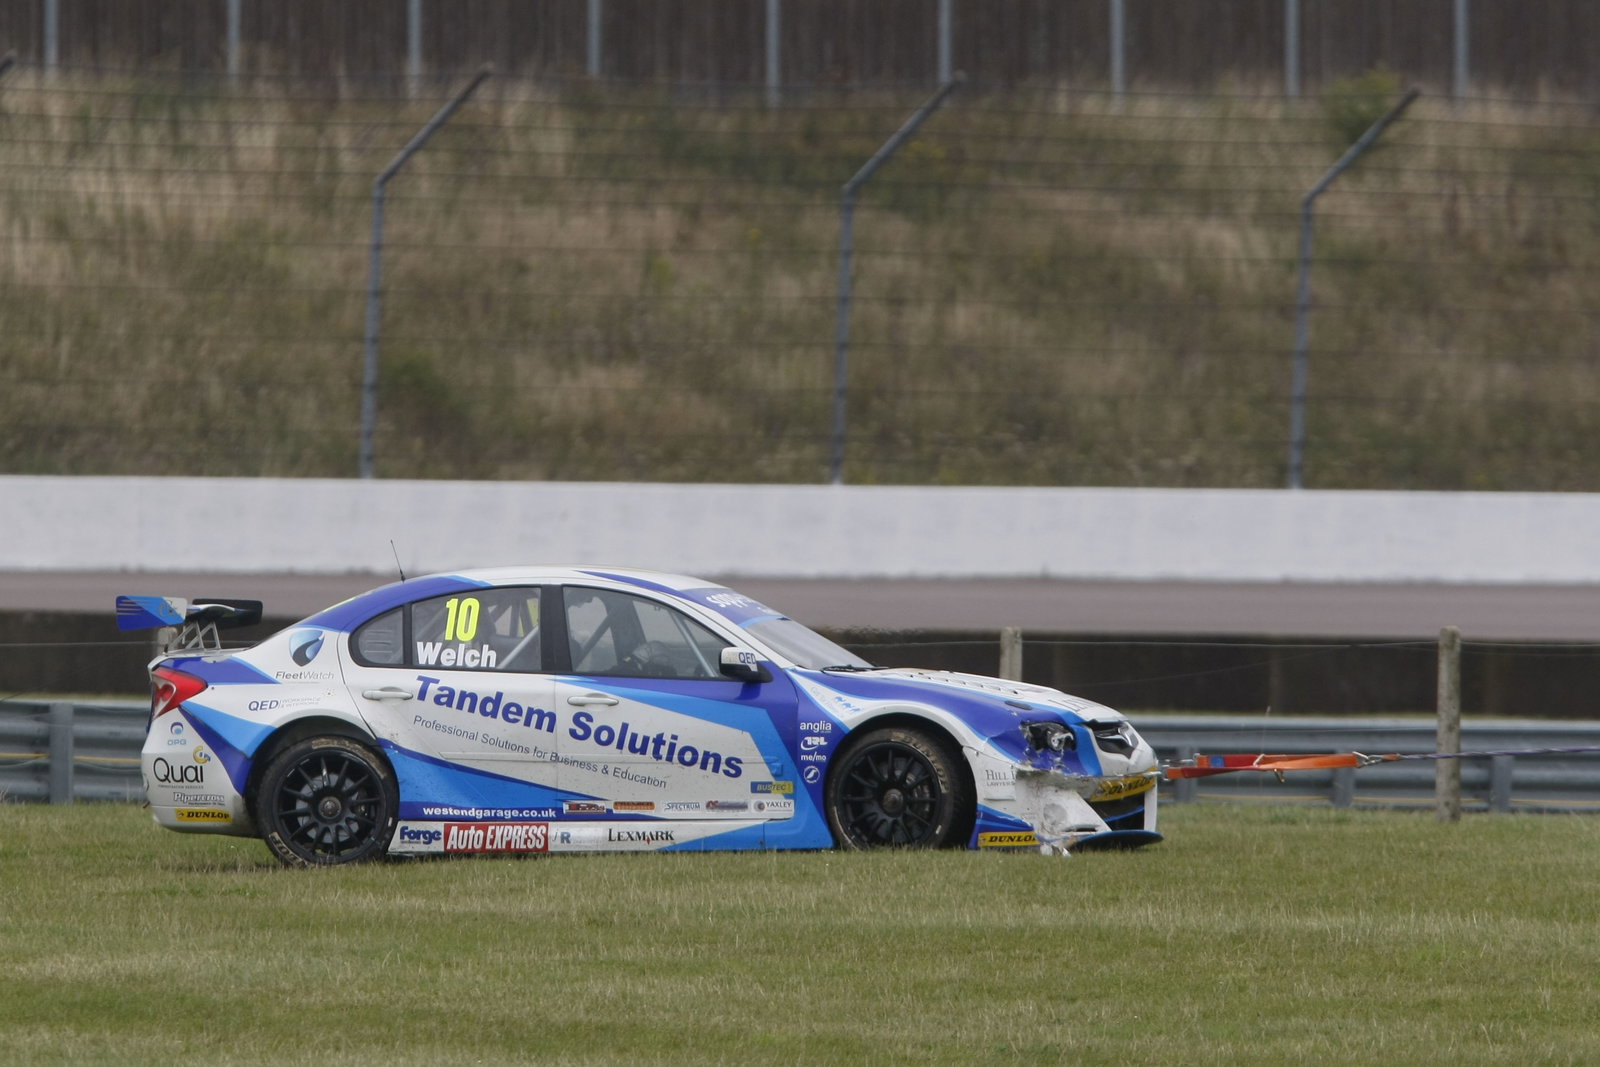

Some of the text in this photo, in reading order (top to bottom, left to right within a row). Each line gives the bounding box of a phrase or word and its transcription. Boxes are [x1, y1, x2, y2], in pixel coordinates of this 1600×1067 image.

[444, 597, 480, 642] 10
[416, 641, 497, 668] Welch
[275, 671, 335, 680] FleetWatch
[248, 699, 279, 711] QED
[415, 675, 743, 779] Tandem Solutions
[800, 720, 832, 733] anglia
[413, 714, 667, 789] Professional Solutions for Business & Education
[153, 757, 204, 783] Quai
[173, 791, 225, 804] Pipercross
[422, 807, 556, 819] westendgarage.co.uk
[446, 825, 547, 850] Auto EXPRESS
[608, 828, 674, 844] LEXMARK
[989, 835, 1036, 843] DUNLO
